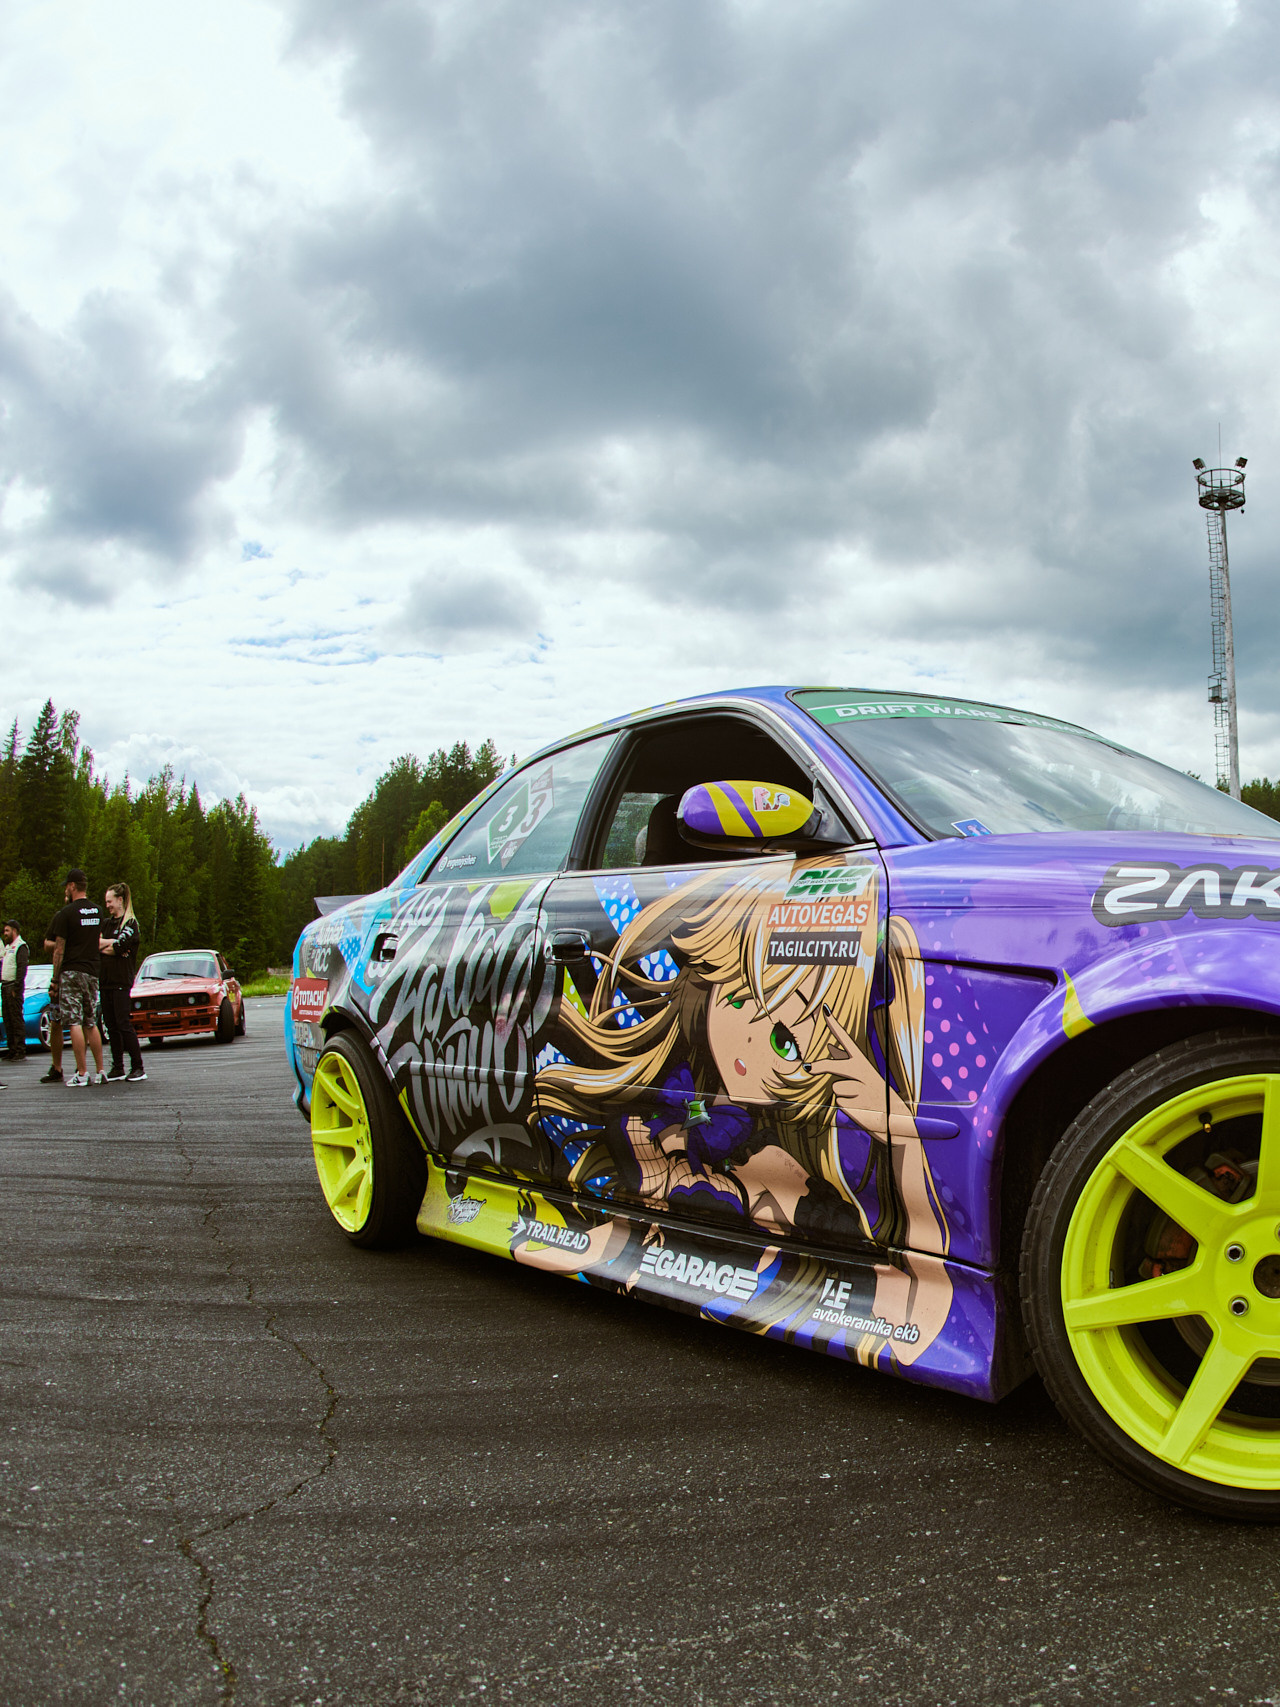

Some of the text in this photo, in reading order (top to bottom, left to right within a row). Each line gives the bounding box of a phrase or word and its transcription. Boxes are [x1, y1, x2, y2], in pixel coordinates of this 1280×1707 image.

[835, 704, 917, 719] DRIFT
[924, 705, 1002, 720] WARS
[785, 867, 873, 897] DWC
[768, 904, 868, 925] AVTOVEGAS
[770, 940, 859, 957] TAGILCITY.RU
[299, 990, 324, 1006] TOTACHI
[526, 1220, 589, 1250] TRAILHEAD
[653, 1249, 759, 1300] GARAGE
[812, 1306, 920, 1343] avtokeramika ekb
